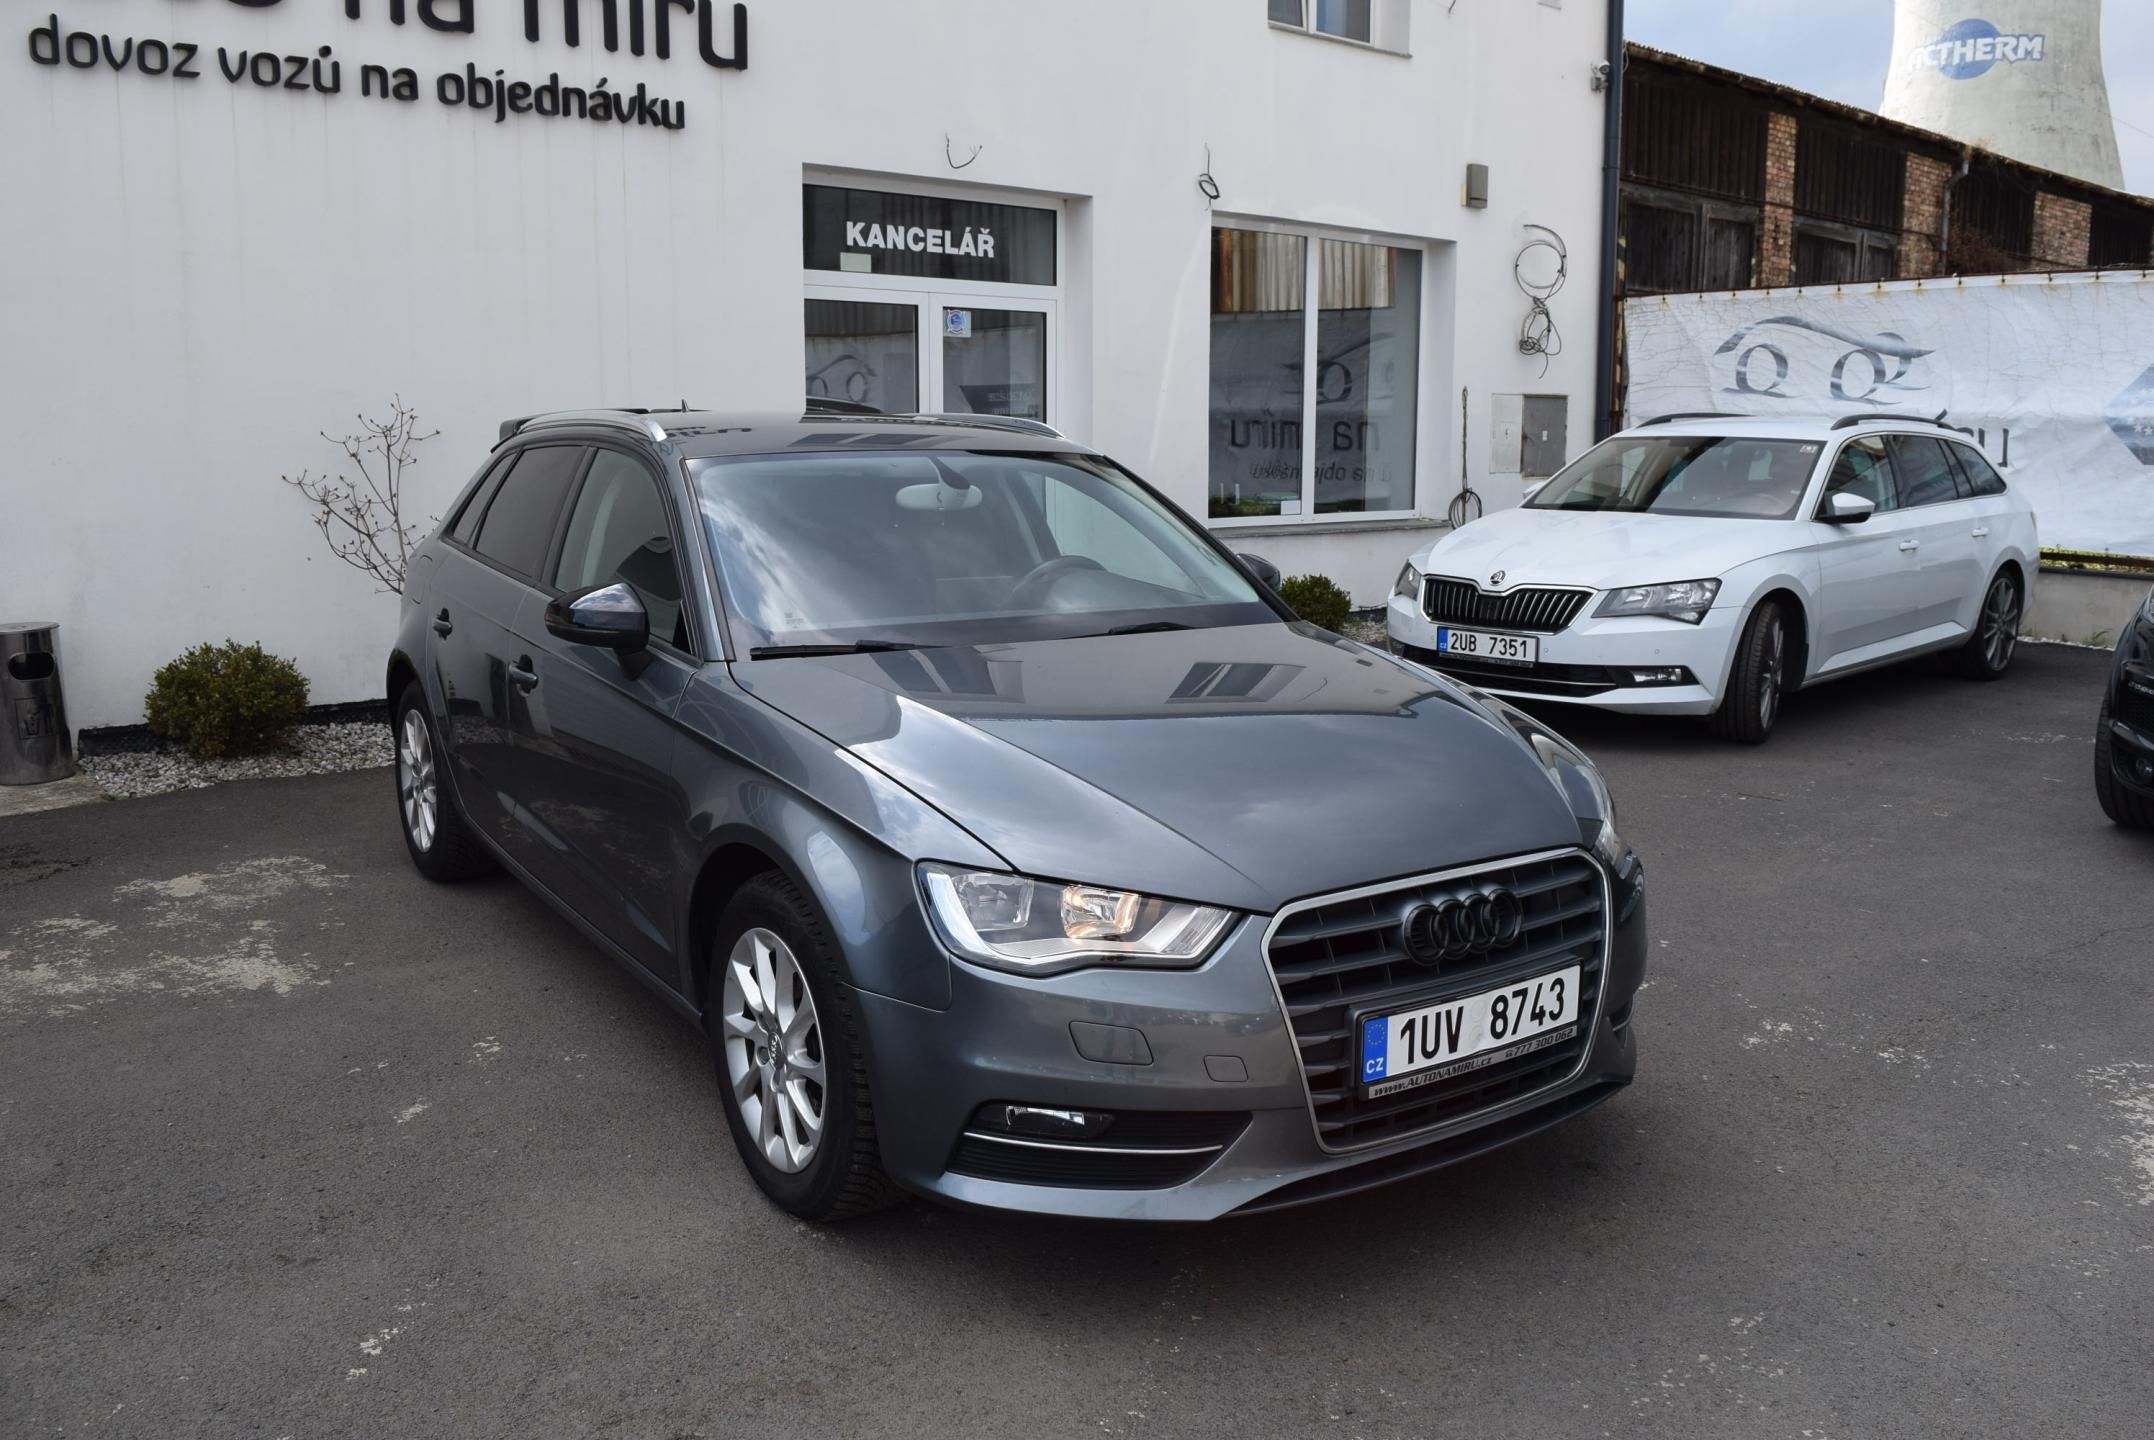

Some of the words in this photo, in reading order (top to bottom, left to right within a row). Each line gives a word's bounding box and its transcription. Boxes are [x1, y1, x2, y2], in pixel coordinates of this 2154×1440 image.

[28, 13, 201, 80] dovoz
[217, 45, 342, 96] vozů
[360, 64, 419, 102] na
[436, 62, 686, 131] objednávku
[846, 221, 995, 258] KANCELÁŘ
[1450, 632, 1478, 653] 2UB
[1488, 636, 1528, 658] 7351
[1400, 1005, 1464, 1065] 1UV
[1490, 977, 1566, 1040] 8743
[1366, 1056, 1384, 1074] CZ
